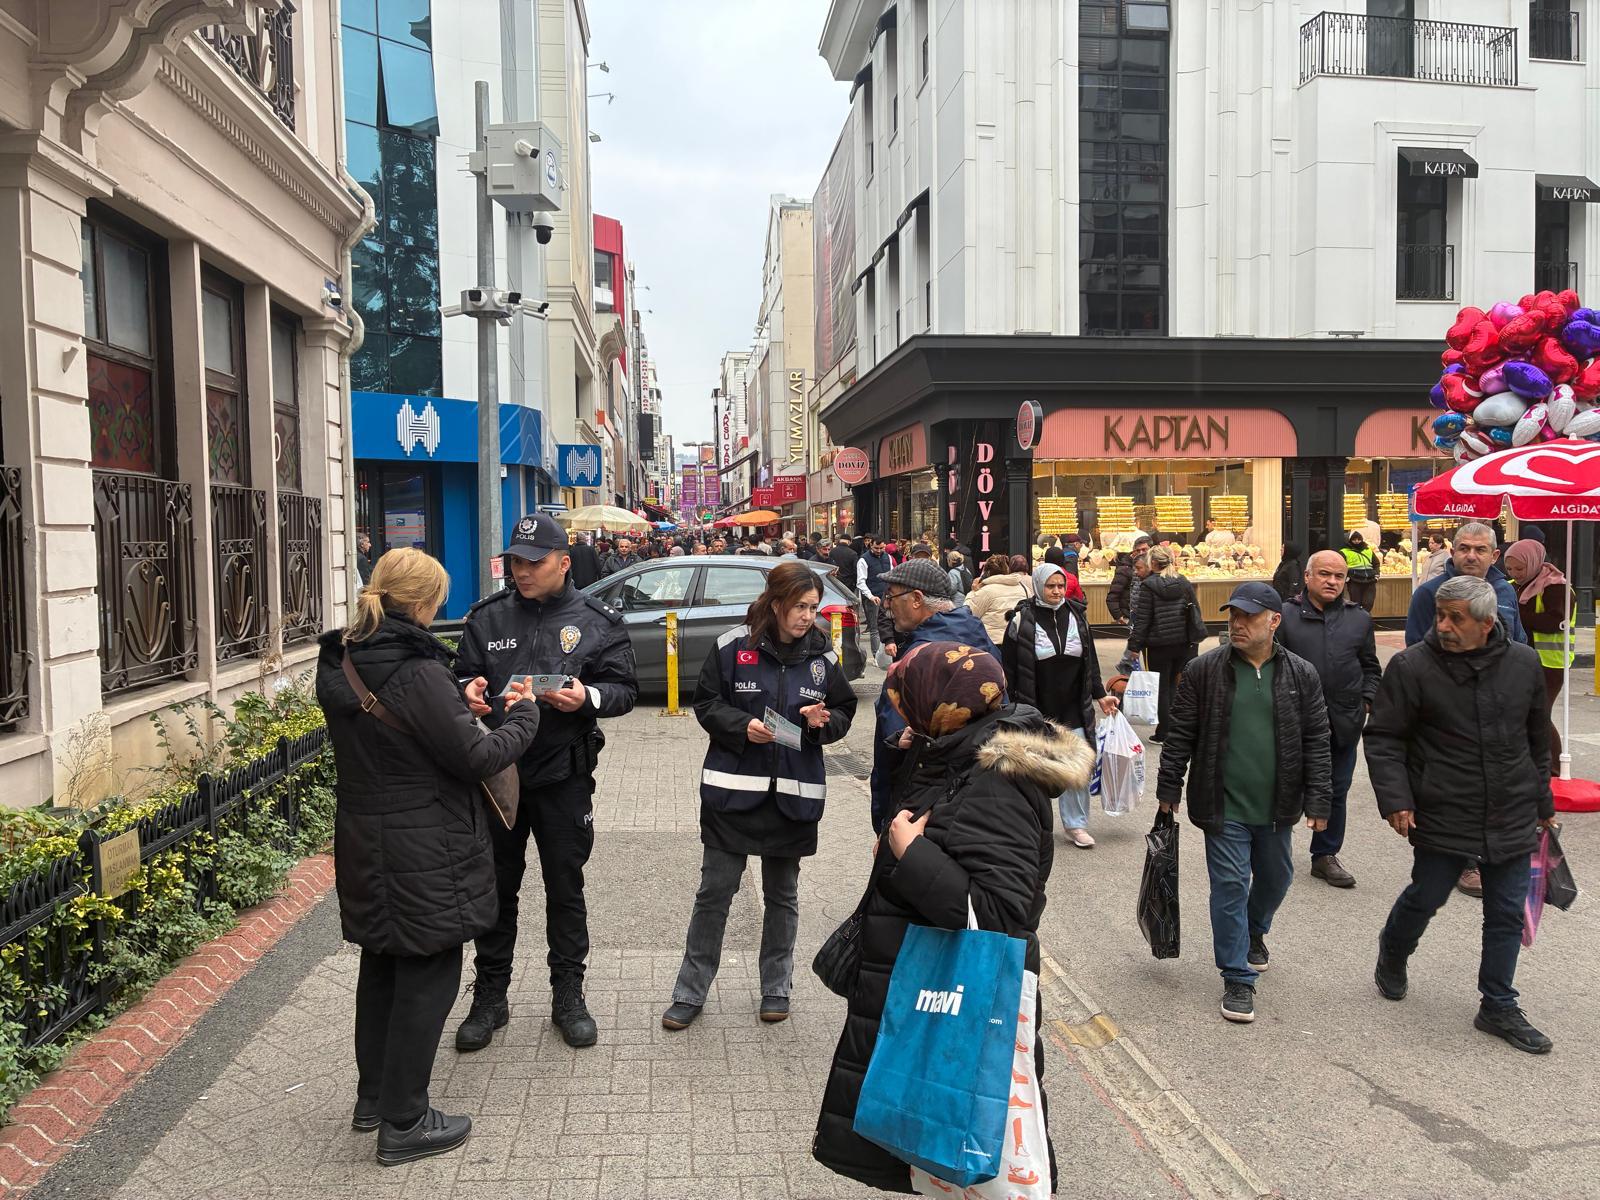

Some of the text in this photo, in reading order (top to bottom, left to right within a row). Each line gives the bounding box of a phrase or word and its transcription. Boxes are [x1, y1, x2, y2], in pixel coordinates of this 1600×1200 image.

[1424, 161, 1467, 175] KAPTAN
[1553, 187, 1591, 200] KAPTAN
[722, 413, 731, 440] AKSU
[789, 371, 803, 464] YILMAZLAR
[1104, 415, 1230, 451] KAPTAN
[914, 984, 964, 1017] mavi
